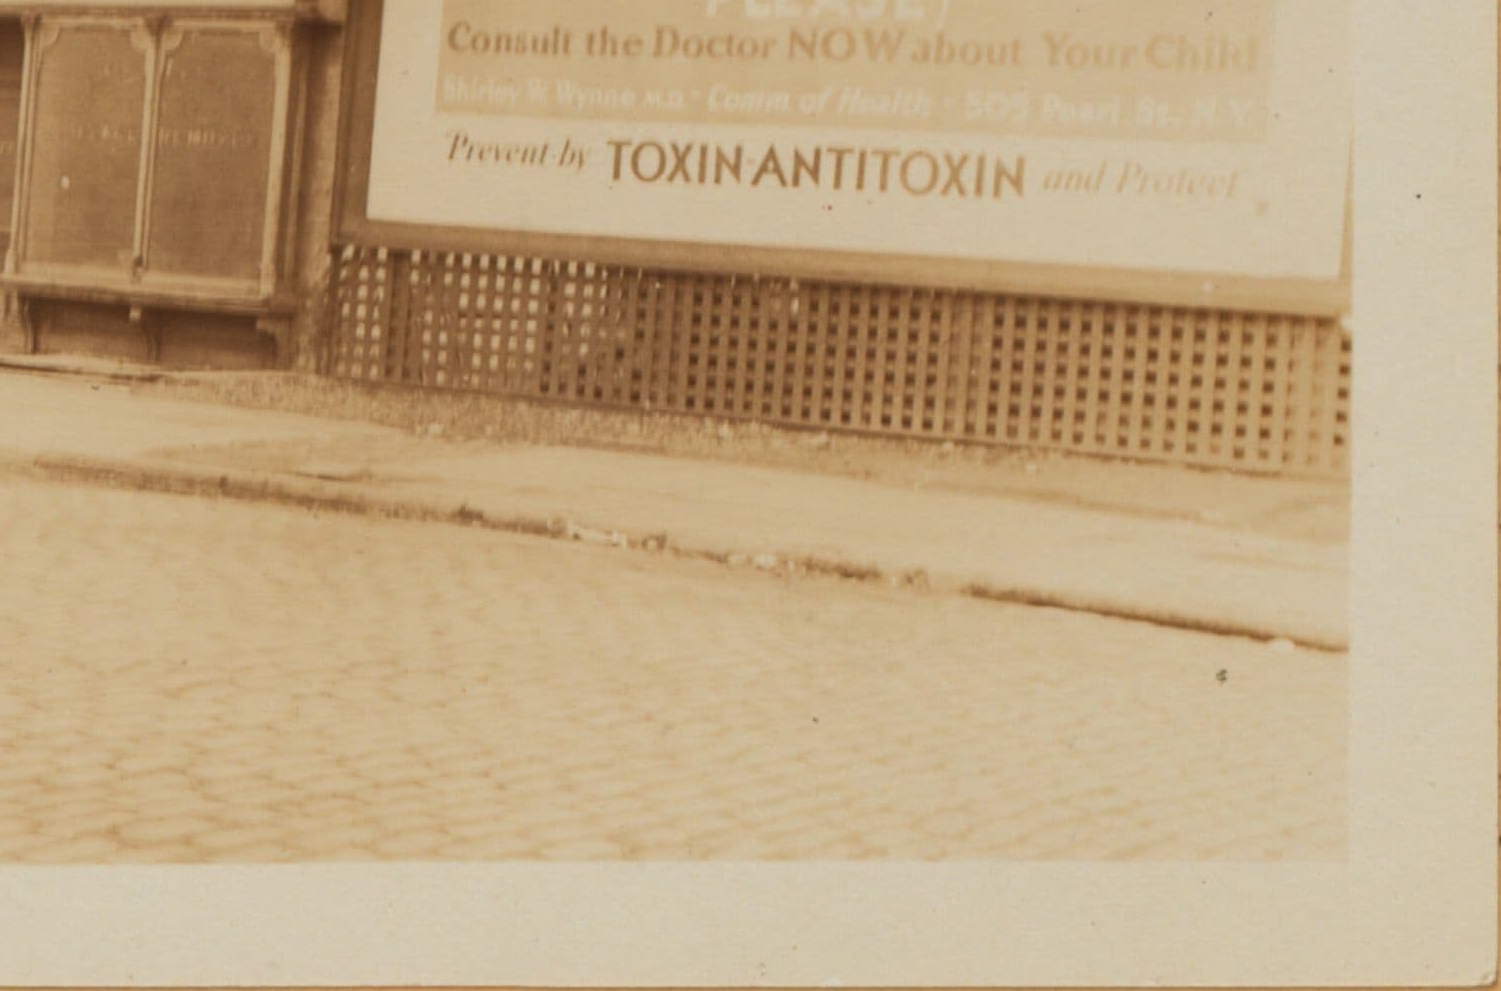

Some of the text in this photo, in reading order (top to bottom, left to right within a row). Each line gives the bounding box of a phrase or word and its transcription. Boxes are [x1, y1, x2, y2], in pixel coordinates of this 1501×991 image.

[447, 20, 572, 58] Consult
[586, 25, 645, 58] the
[651, 24, 777, 61] Doctor
[788, 25, 906, 64] NOW
[910, 31, 1023, 67] about
[1041, 29, 1138, 71] Your
[799, 85, 834, 115] of
[445, 130, 549, 166] Prevent
[558, 138, 592, 170] by
[1042, 160, 1106, 192] and
[1116, 161, 1239, 198] Protect
